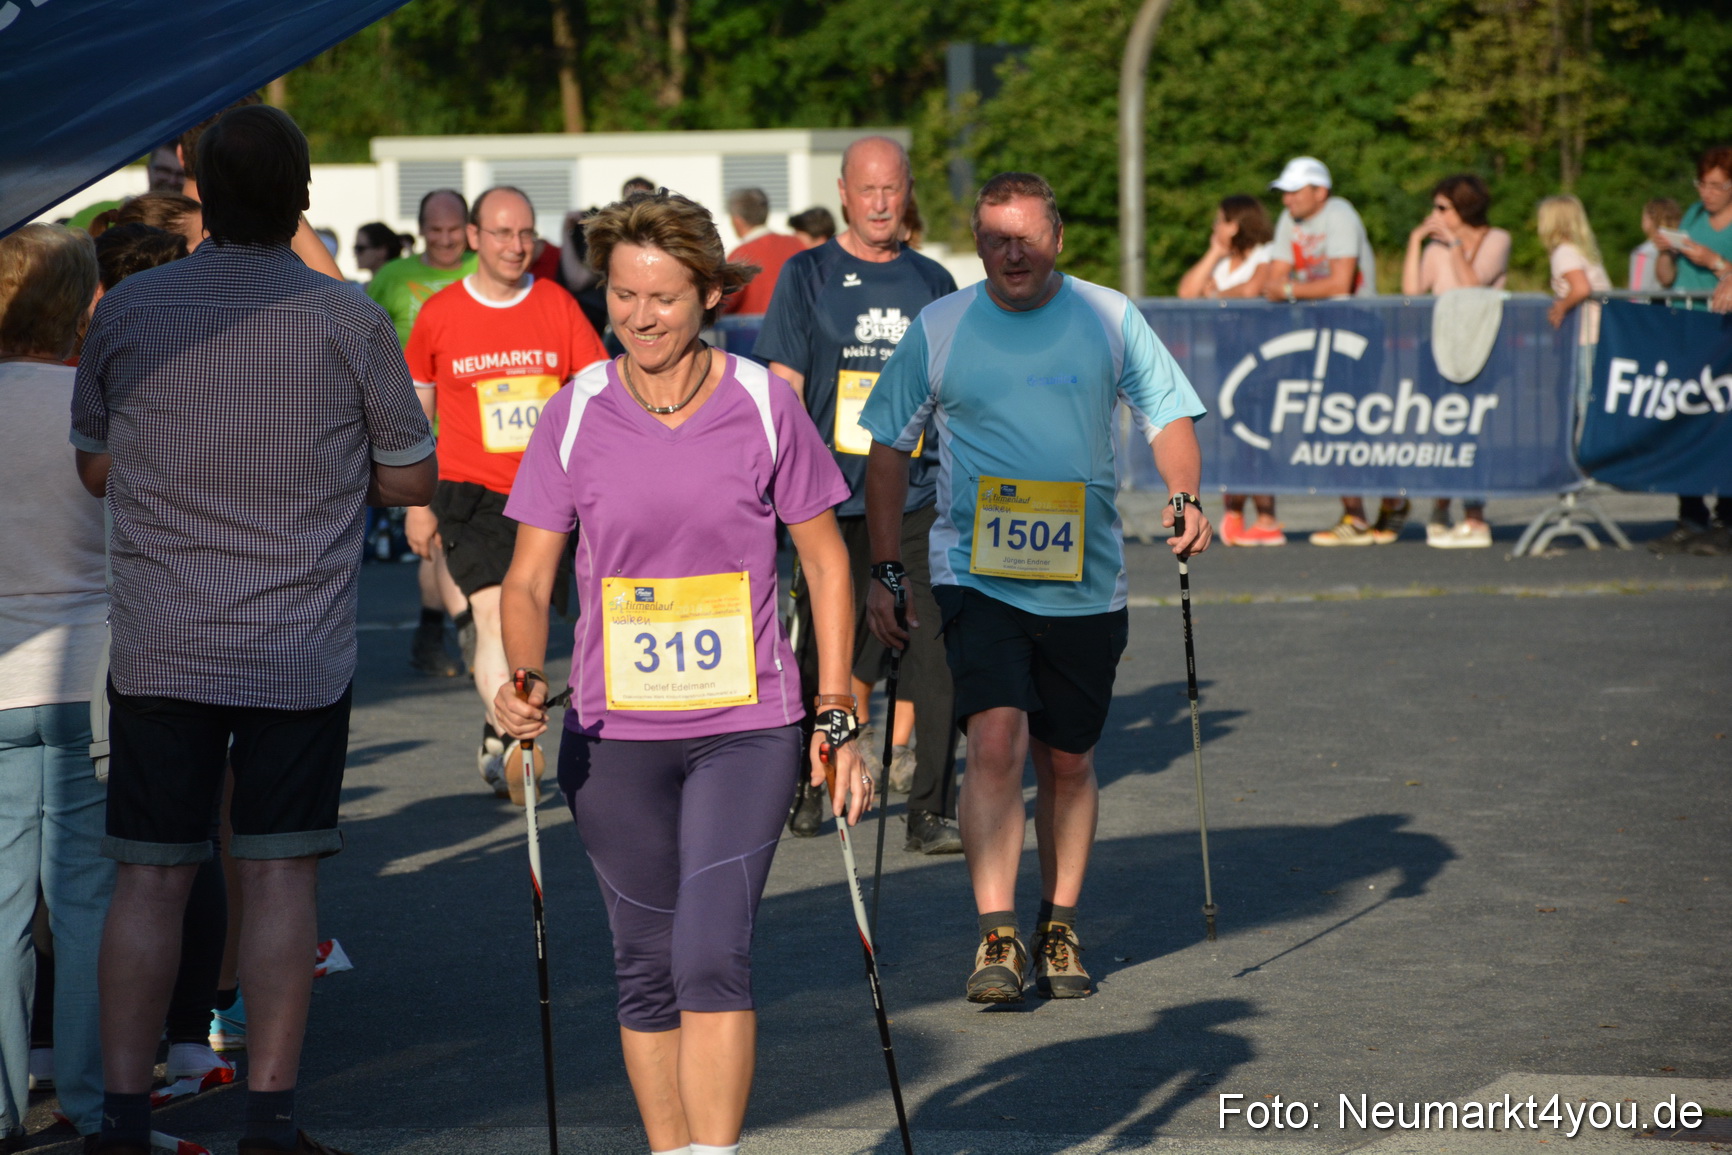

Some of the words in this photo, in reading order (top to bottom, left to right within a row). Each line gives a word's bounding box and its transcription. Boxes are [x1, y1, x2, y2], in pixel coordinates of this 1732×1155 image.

[453, 351, 542, 375] NEUMARKT
[842, 345, 876, 359] Weil's
[1605, 356, 1732, 422] Frisch
[1270, 377, 1499, 435] Fischer
[1290, 441, 1478, 467] AUTOMOBILE
[993, 493, 1031, 504] firmenlauf
[986, 517, 1074, 553] 1504
[1002, 556, 1026, 566] Jürgen
[1027, 558, 1051, 566] Endner
[886, 564, 898, 587] LEKI
[625, 600, 674, 611] firmenlauf
[634, 629, 722, 673] 319
[643, 682, 670, 692] Detlef
[672, 681, 715, 692] Edelmann
